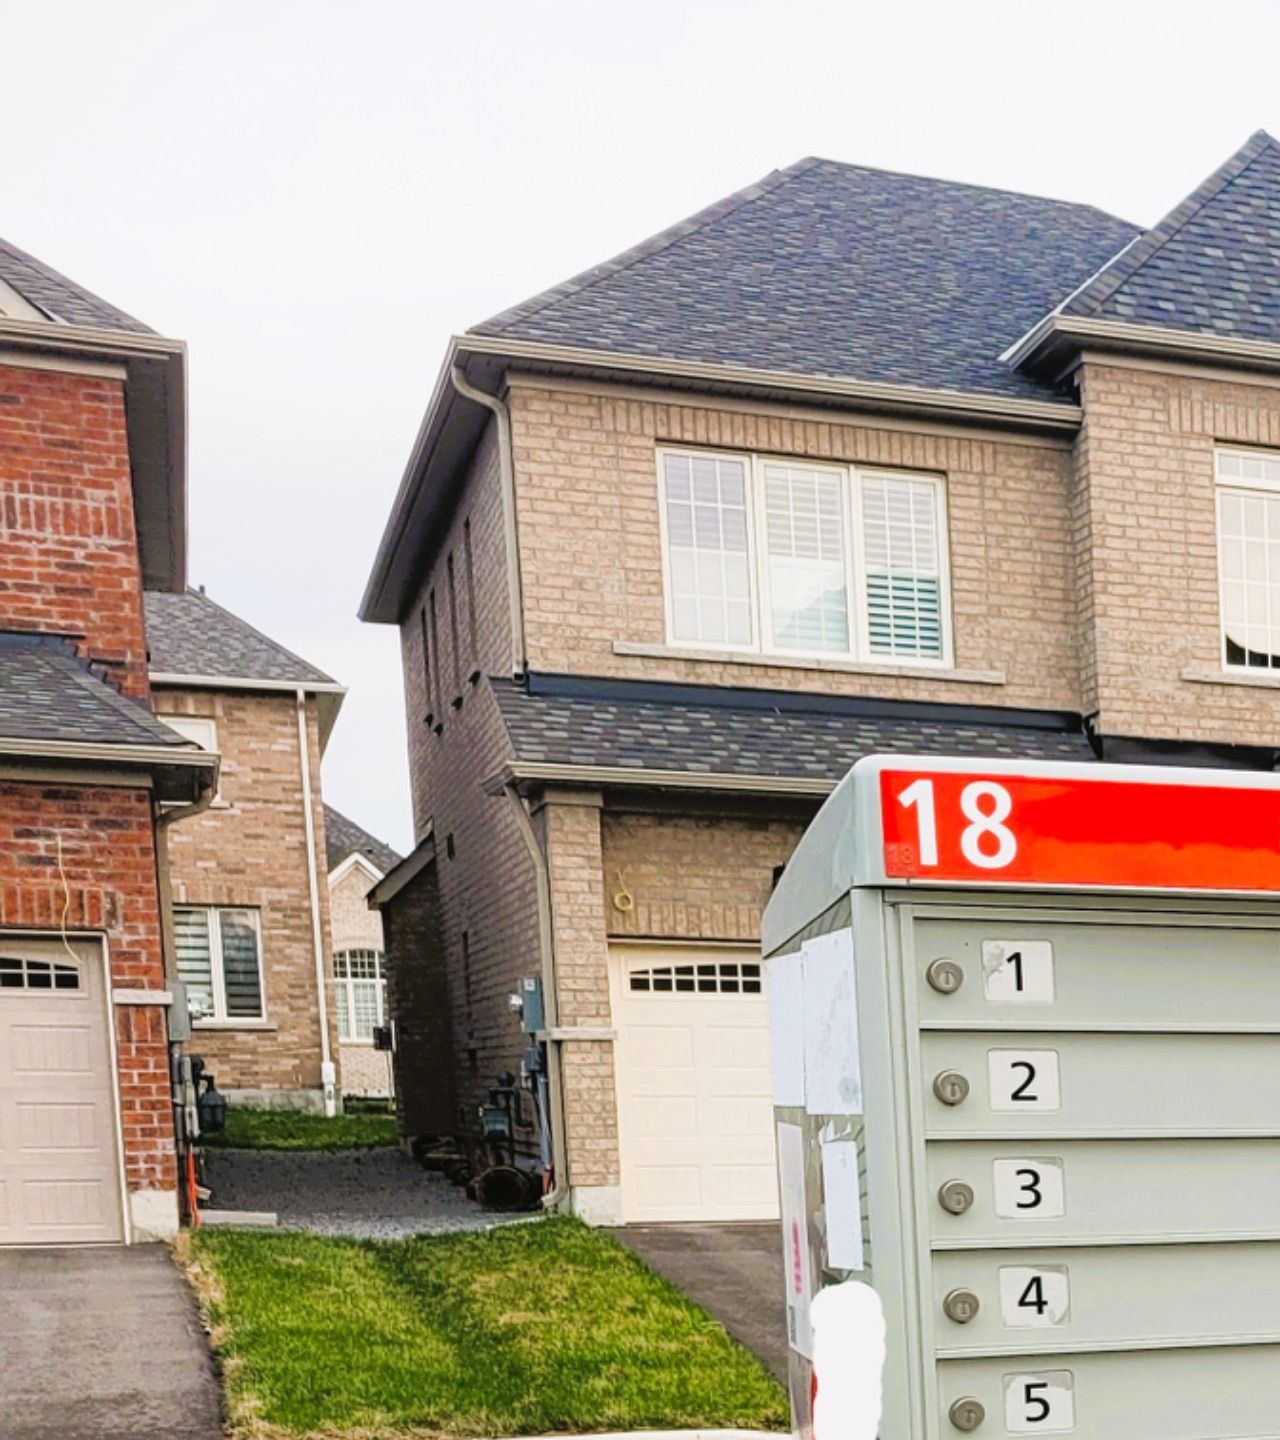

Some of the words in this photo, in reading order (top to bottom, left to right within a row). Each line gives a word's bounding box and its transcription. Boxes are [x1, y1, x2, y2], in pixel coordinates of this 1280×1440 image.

[897, 779, 1017, 869] 18
[1007, 952, 1022, 991] 1
[1012, 1062, 1037, 1100] 2
[1017, 1169, 1041, 1208] 3
[1019, 1277, 1047, 1314] 4
[1025, 1383, 1049, 1421] 5
